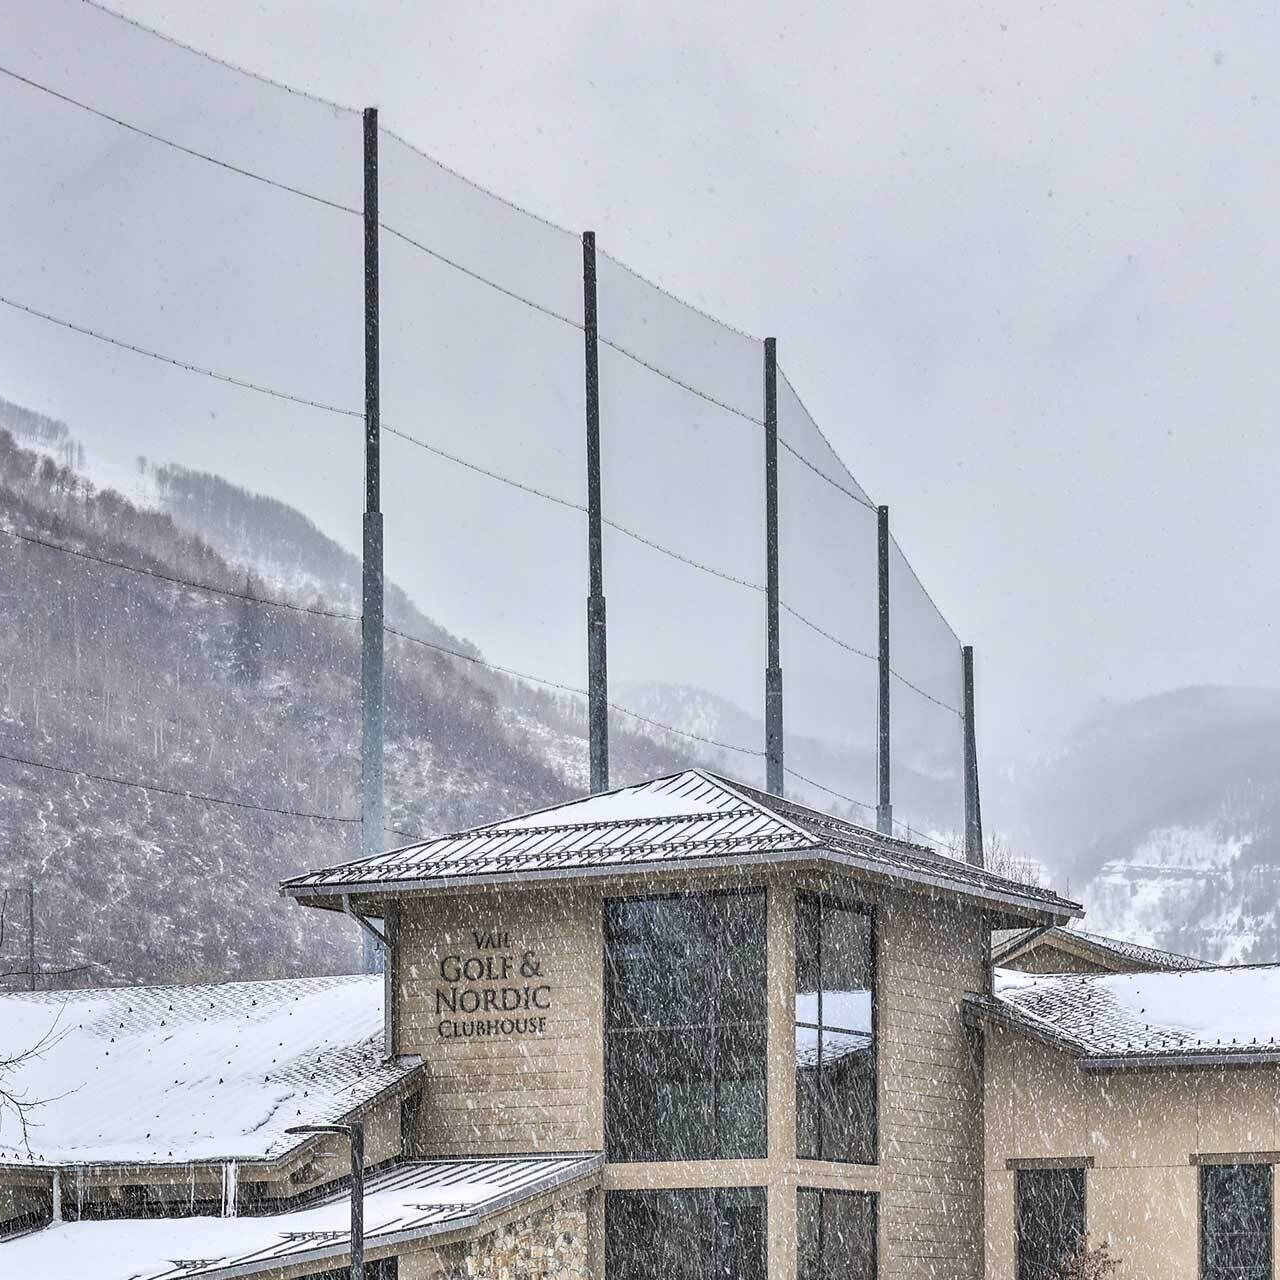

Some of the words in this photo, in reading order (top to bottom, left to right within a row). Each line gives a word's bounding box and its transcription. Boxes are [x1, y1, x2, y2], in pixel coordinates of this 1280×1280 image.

[472, 931, 512, 949] VAIL
[440, 955, 514, 982] GOLF
[519, 951, 544, 978] &
[435, 985, 551, 1014] NORDIC
[438, 1016, 547, 1038] CLUBHOUSE
